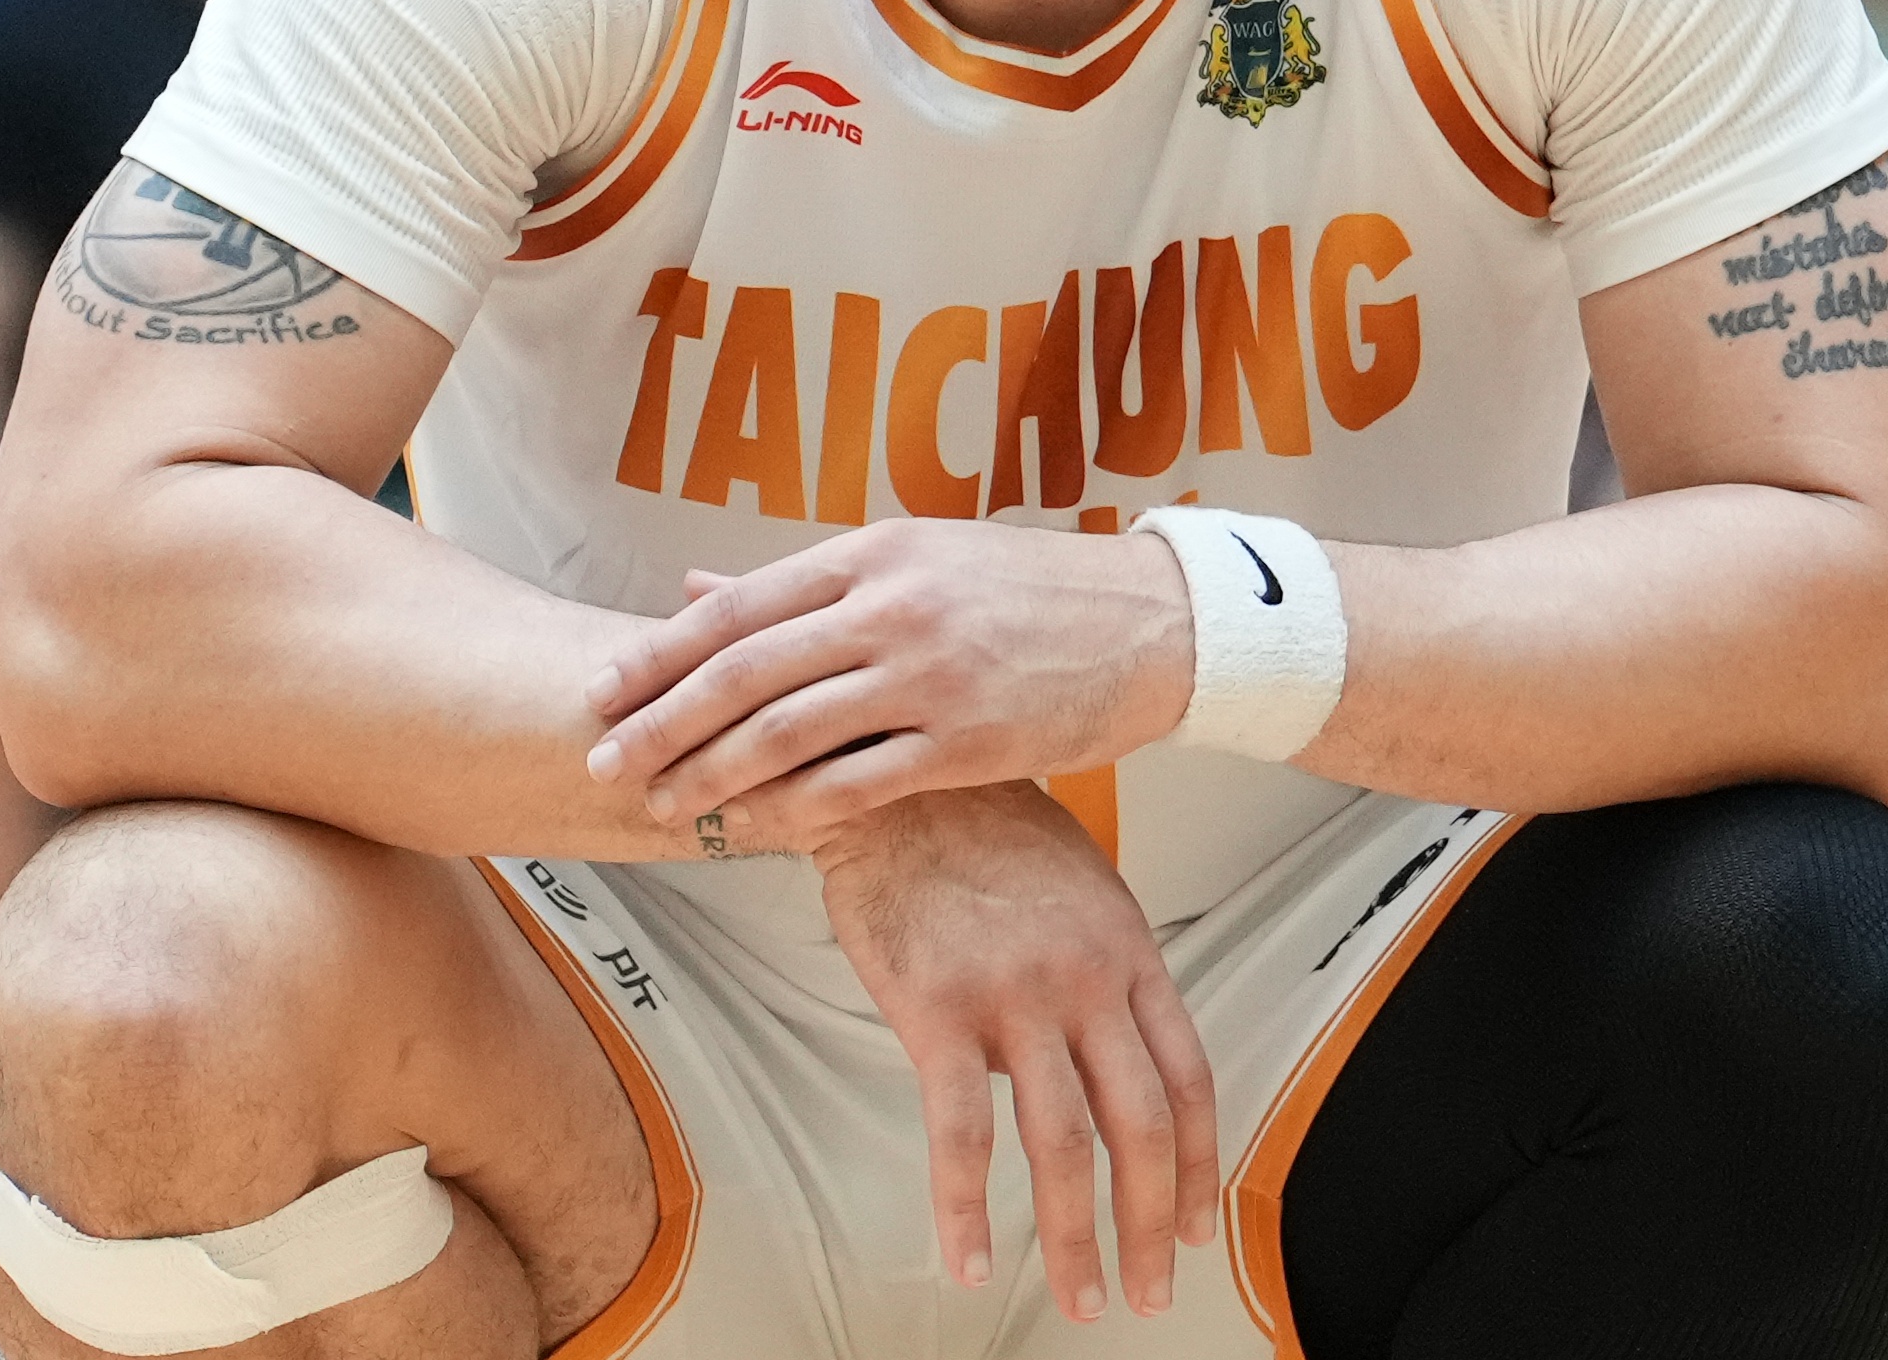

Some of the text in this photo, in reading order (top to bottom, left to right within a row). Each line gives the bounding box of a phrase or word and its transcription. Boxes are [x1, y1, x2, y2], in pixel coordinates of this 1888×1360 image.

[737, 109, 863, 146] LI-NING
[134, 311, 361, 344] Sacrifice
[616, 213, 1422, 527] TAICHUNG
